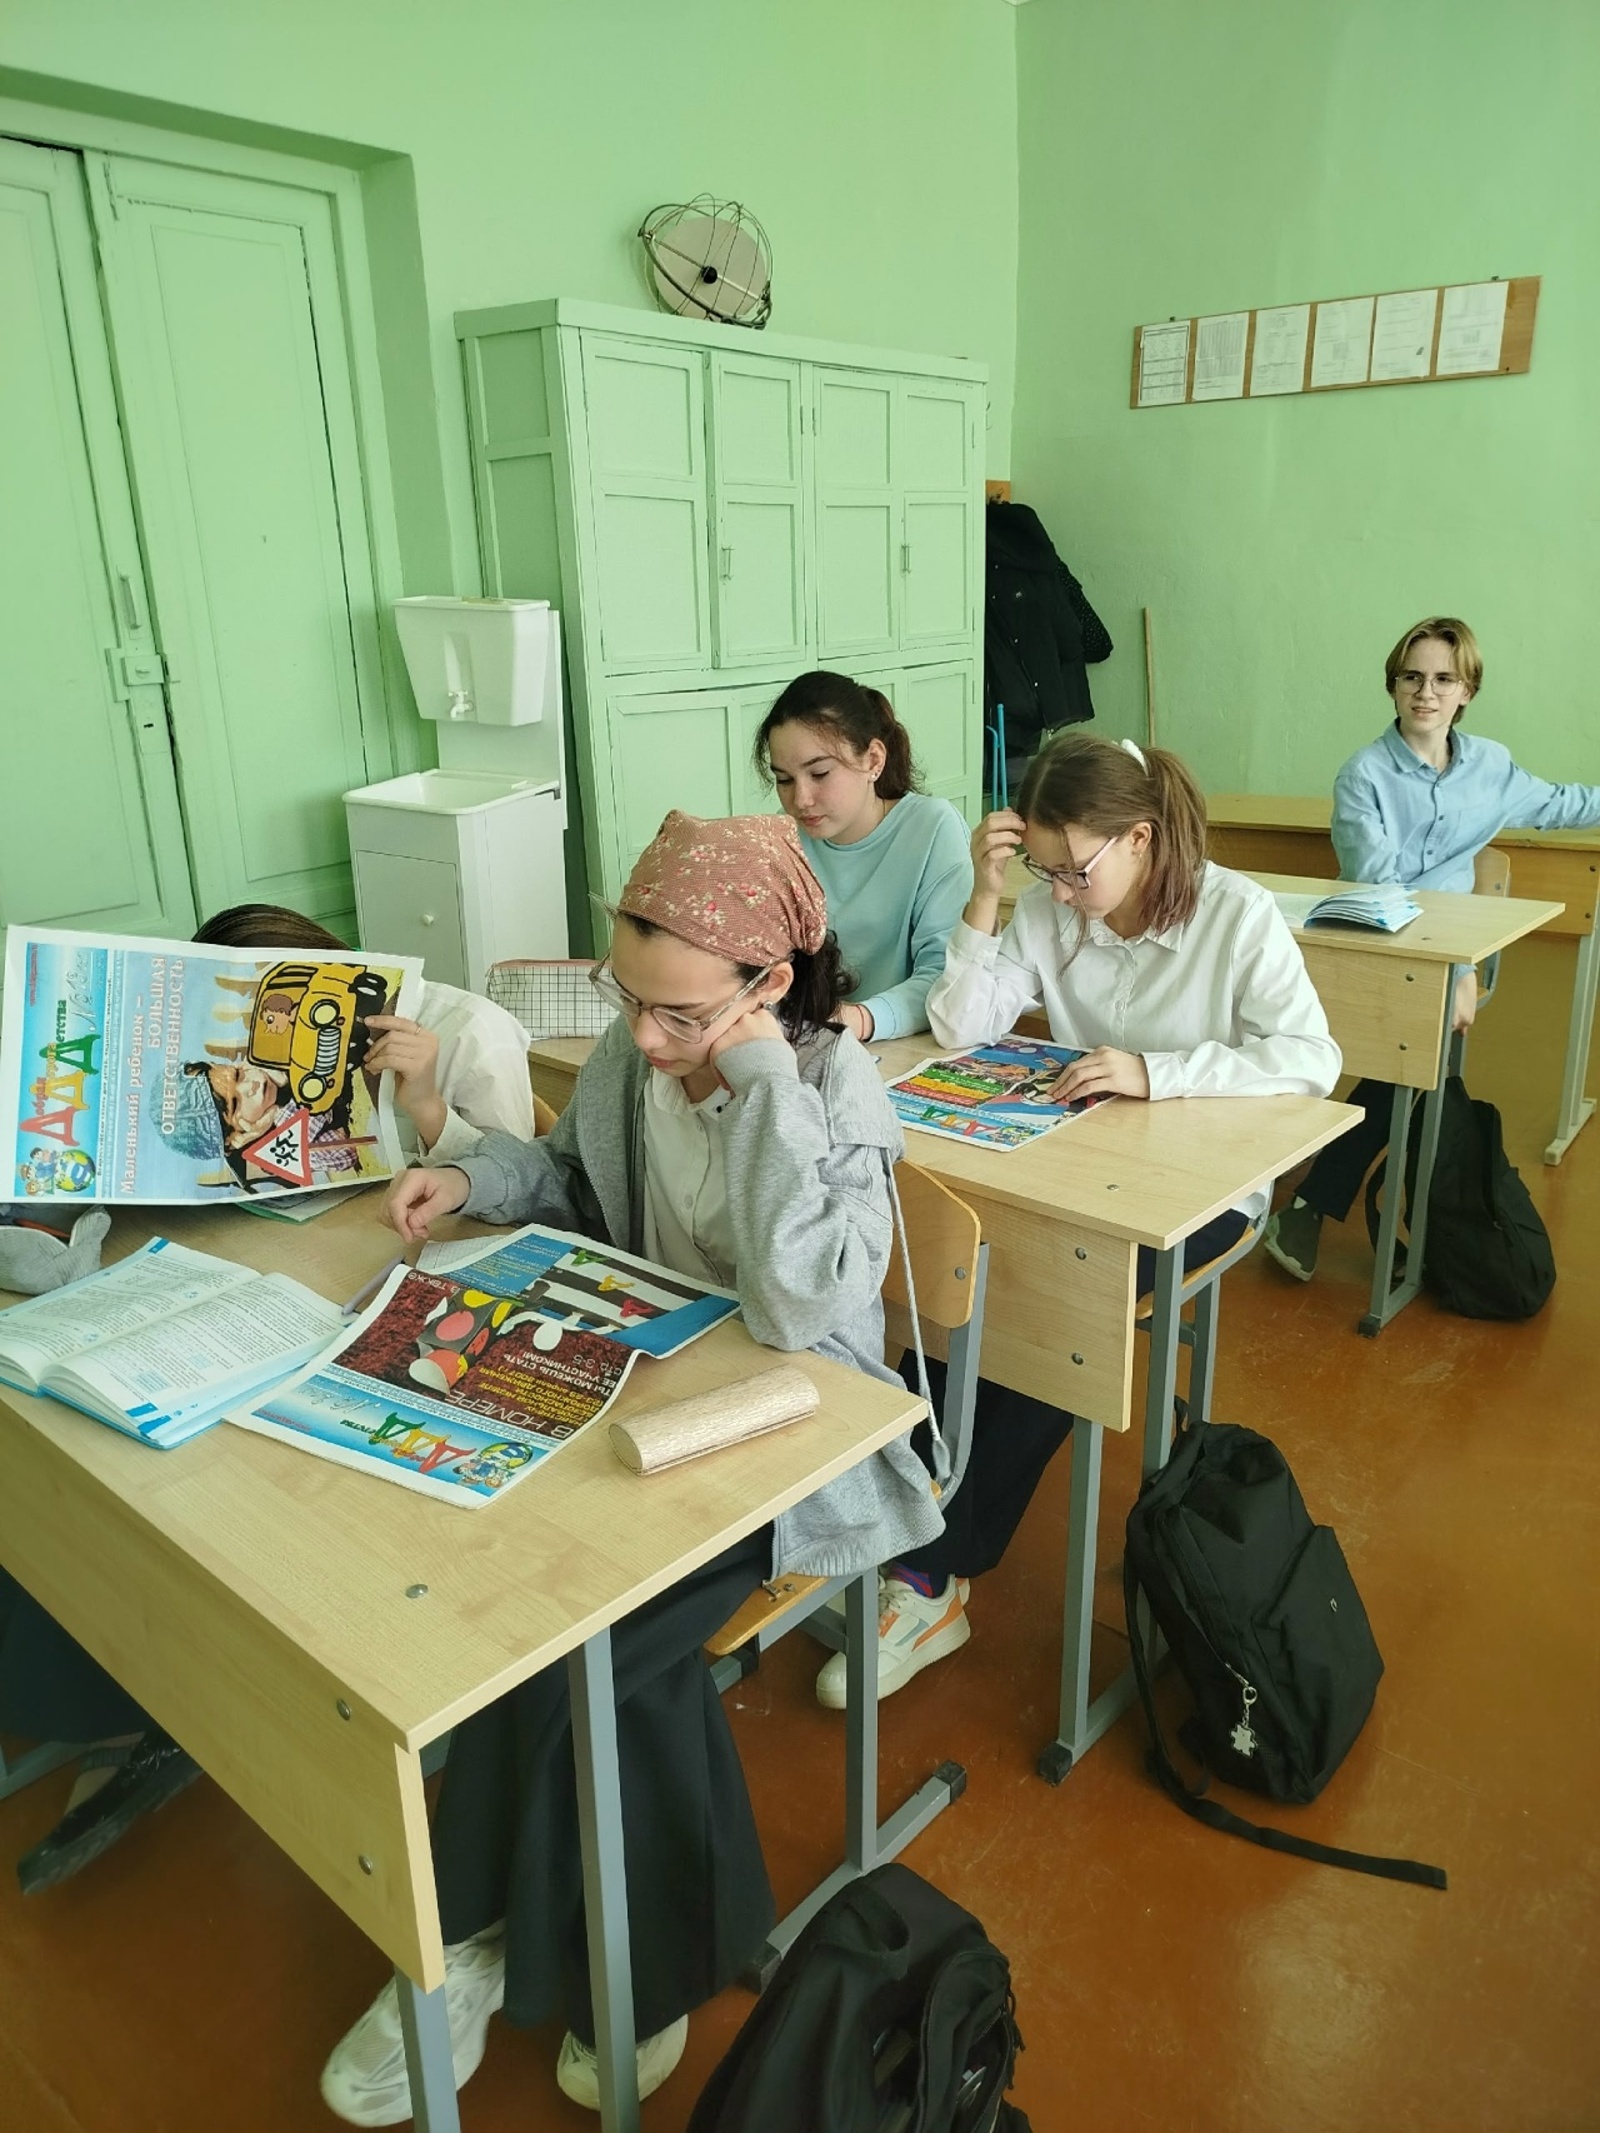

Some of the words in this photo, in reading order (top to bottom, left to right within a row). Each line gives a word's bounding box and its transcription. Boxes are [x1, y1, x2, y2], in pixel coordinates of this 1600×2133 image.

[149, 957, 166, 1049] БОЛЬШАЯ
[127, 1014, 144, 1088] ребенок
[162, 959, 184, 1134] ОТВЕТСТВЕННОСТЬ
[120, 1093, 140, 1194] Маленький
[501, 1352, 538, 1370] СТАТЬ
[520, 1350, 601, 1382] УЧАСТНИКОМ!
[570, 1353, 596, 1369] 3-5
[477, 1366, 537, 1390] ДВИЖЕНИЯ
[477, 1381, 517, 1398] НЕДЕЛЕ
[537, 1365, 593, 1389] МОЖЕШЬ
[592, 1384, 611, 1396] ТЫ
[444, 1390, 548, 1430] НОМЕРЕ
[513, 1387, 594, 1418] БЕЗОПАСНОСТИ
[515, 1394, 584, 1421] ГЛОБАЛЬНОЙ
[533, 1386, 600, 1413] ДОРОЖНОГО
[526, 1406, 583, 1426] НАВСТРЕЧУ
[551, 1425, 575, 1438] В
